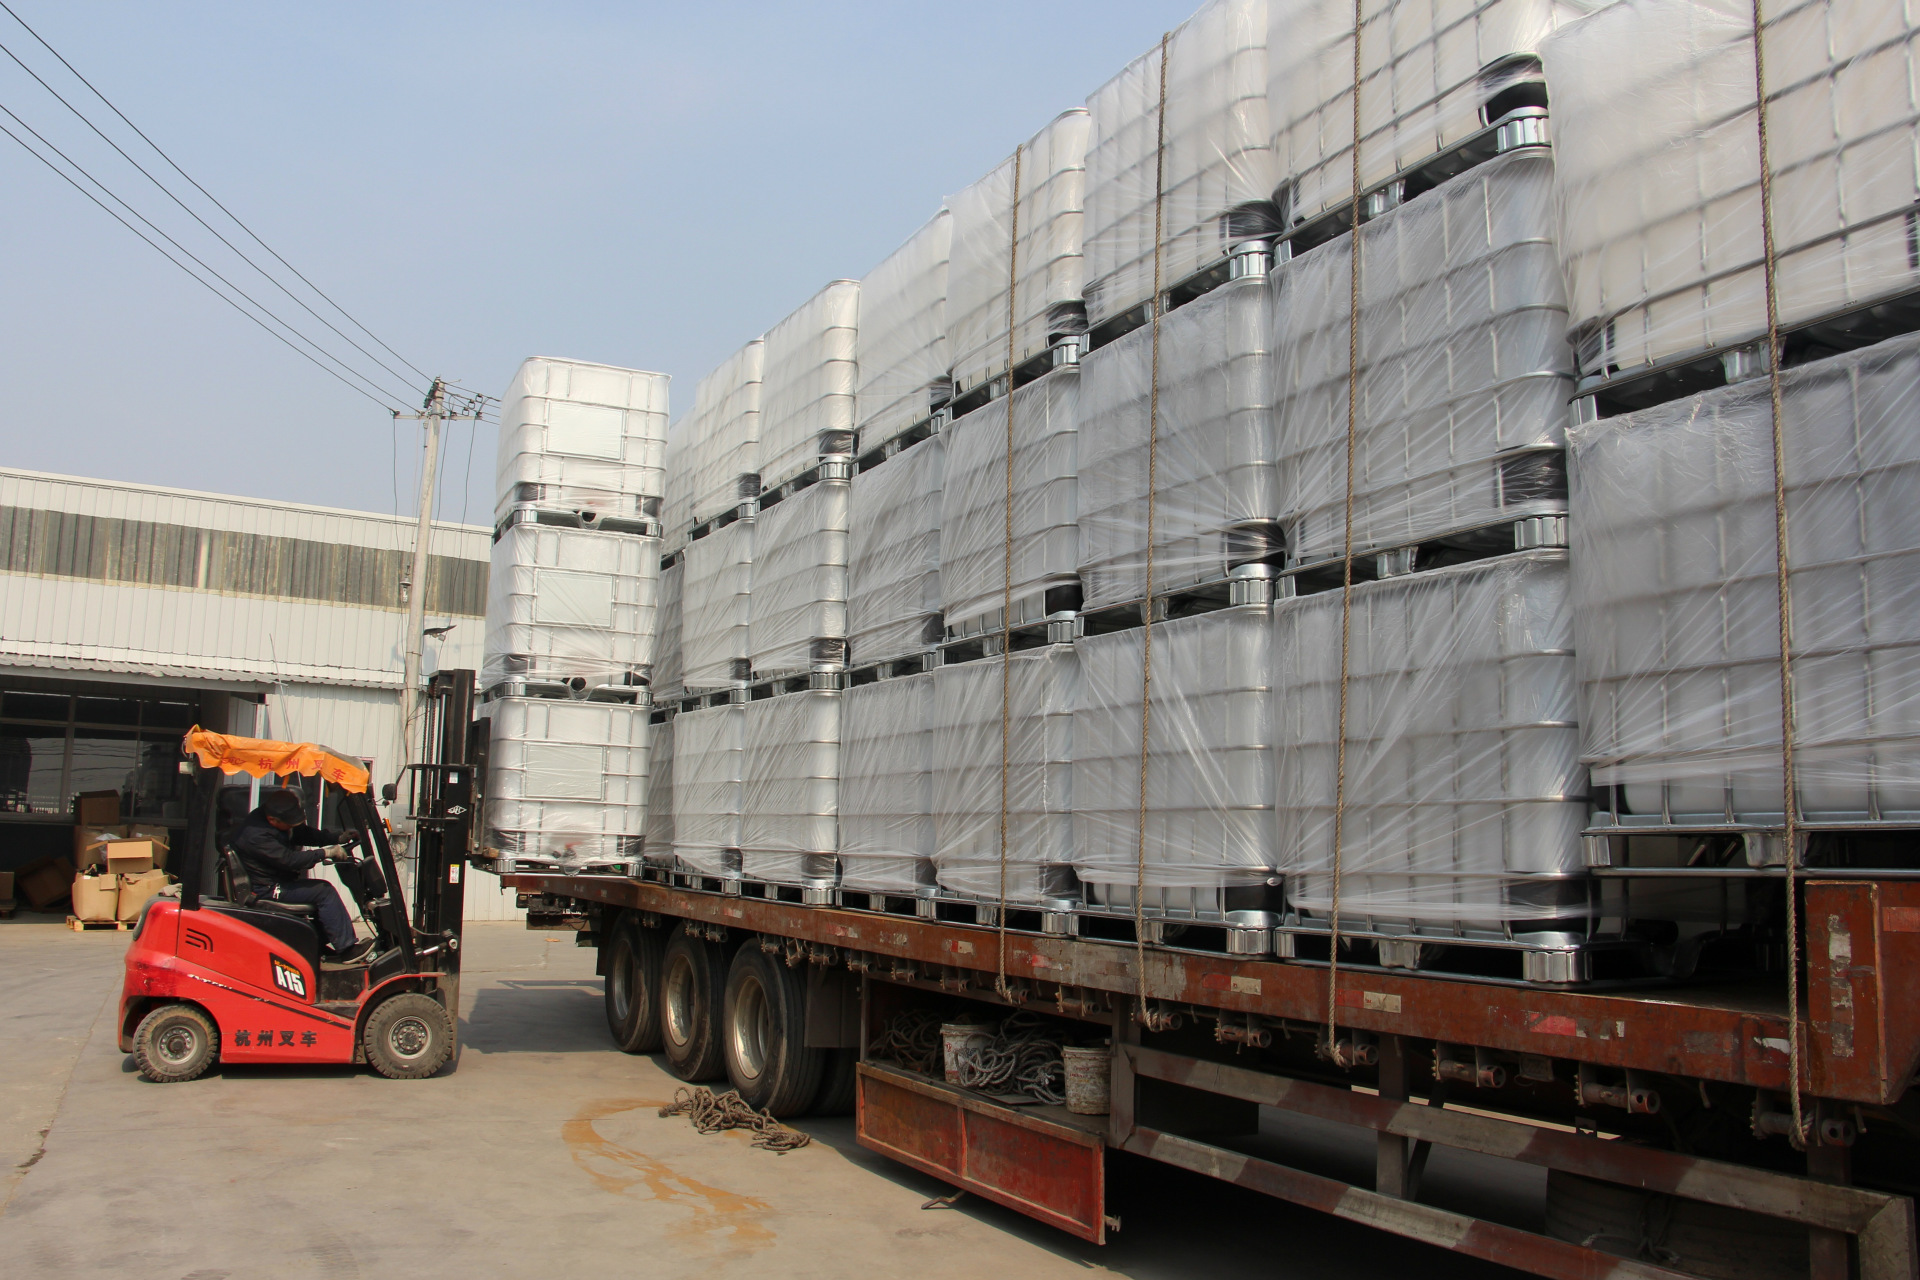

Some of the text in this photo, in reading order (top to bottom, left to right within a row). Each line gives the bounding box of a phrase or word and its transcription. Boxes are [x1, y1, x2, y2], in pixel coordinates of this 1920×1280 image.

[259, 758, 346, 781] 杭州叉车
[275, 965, 305, 995] A15
[234, 1029, 317, 1047] 杭州叉车
